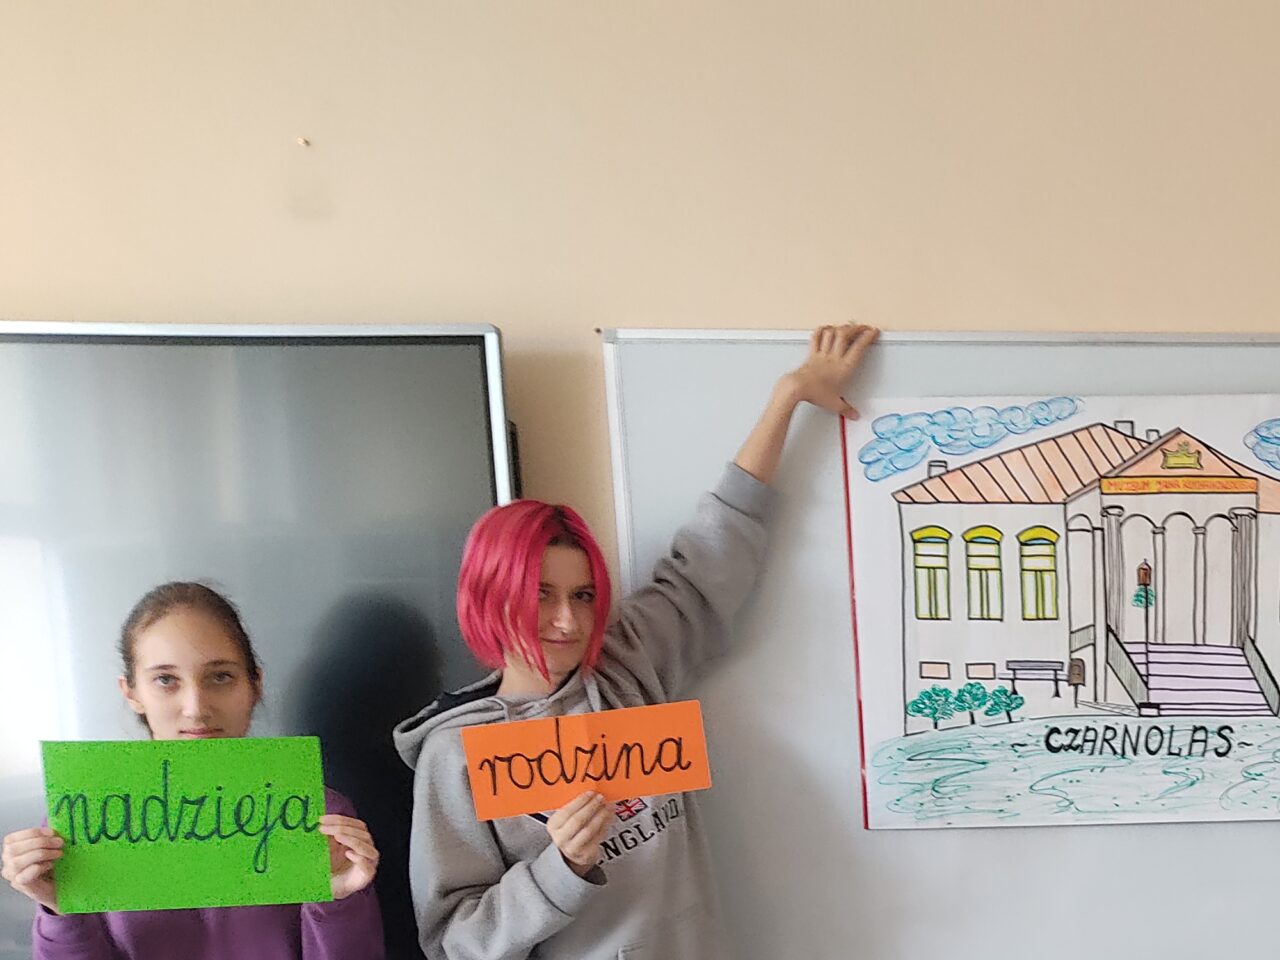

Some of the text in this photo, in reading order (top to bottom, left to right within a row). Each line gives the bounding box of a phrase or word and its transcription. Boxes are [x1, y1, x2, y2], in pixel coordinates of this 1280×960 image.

[478, 717, 692, 796] rodzina
[1045, 724, 1235, 758] CZARNOLAS
[53, 759, 320, 873] nadzieja
